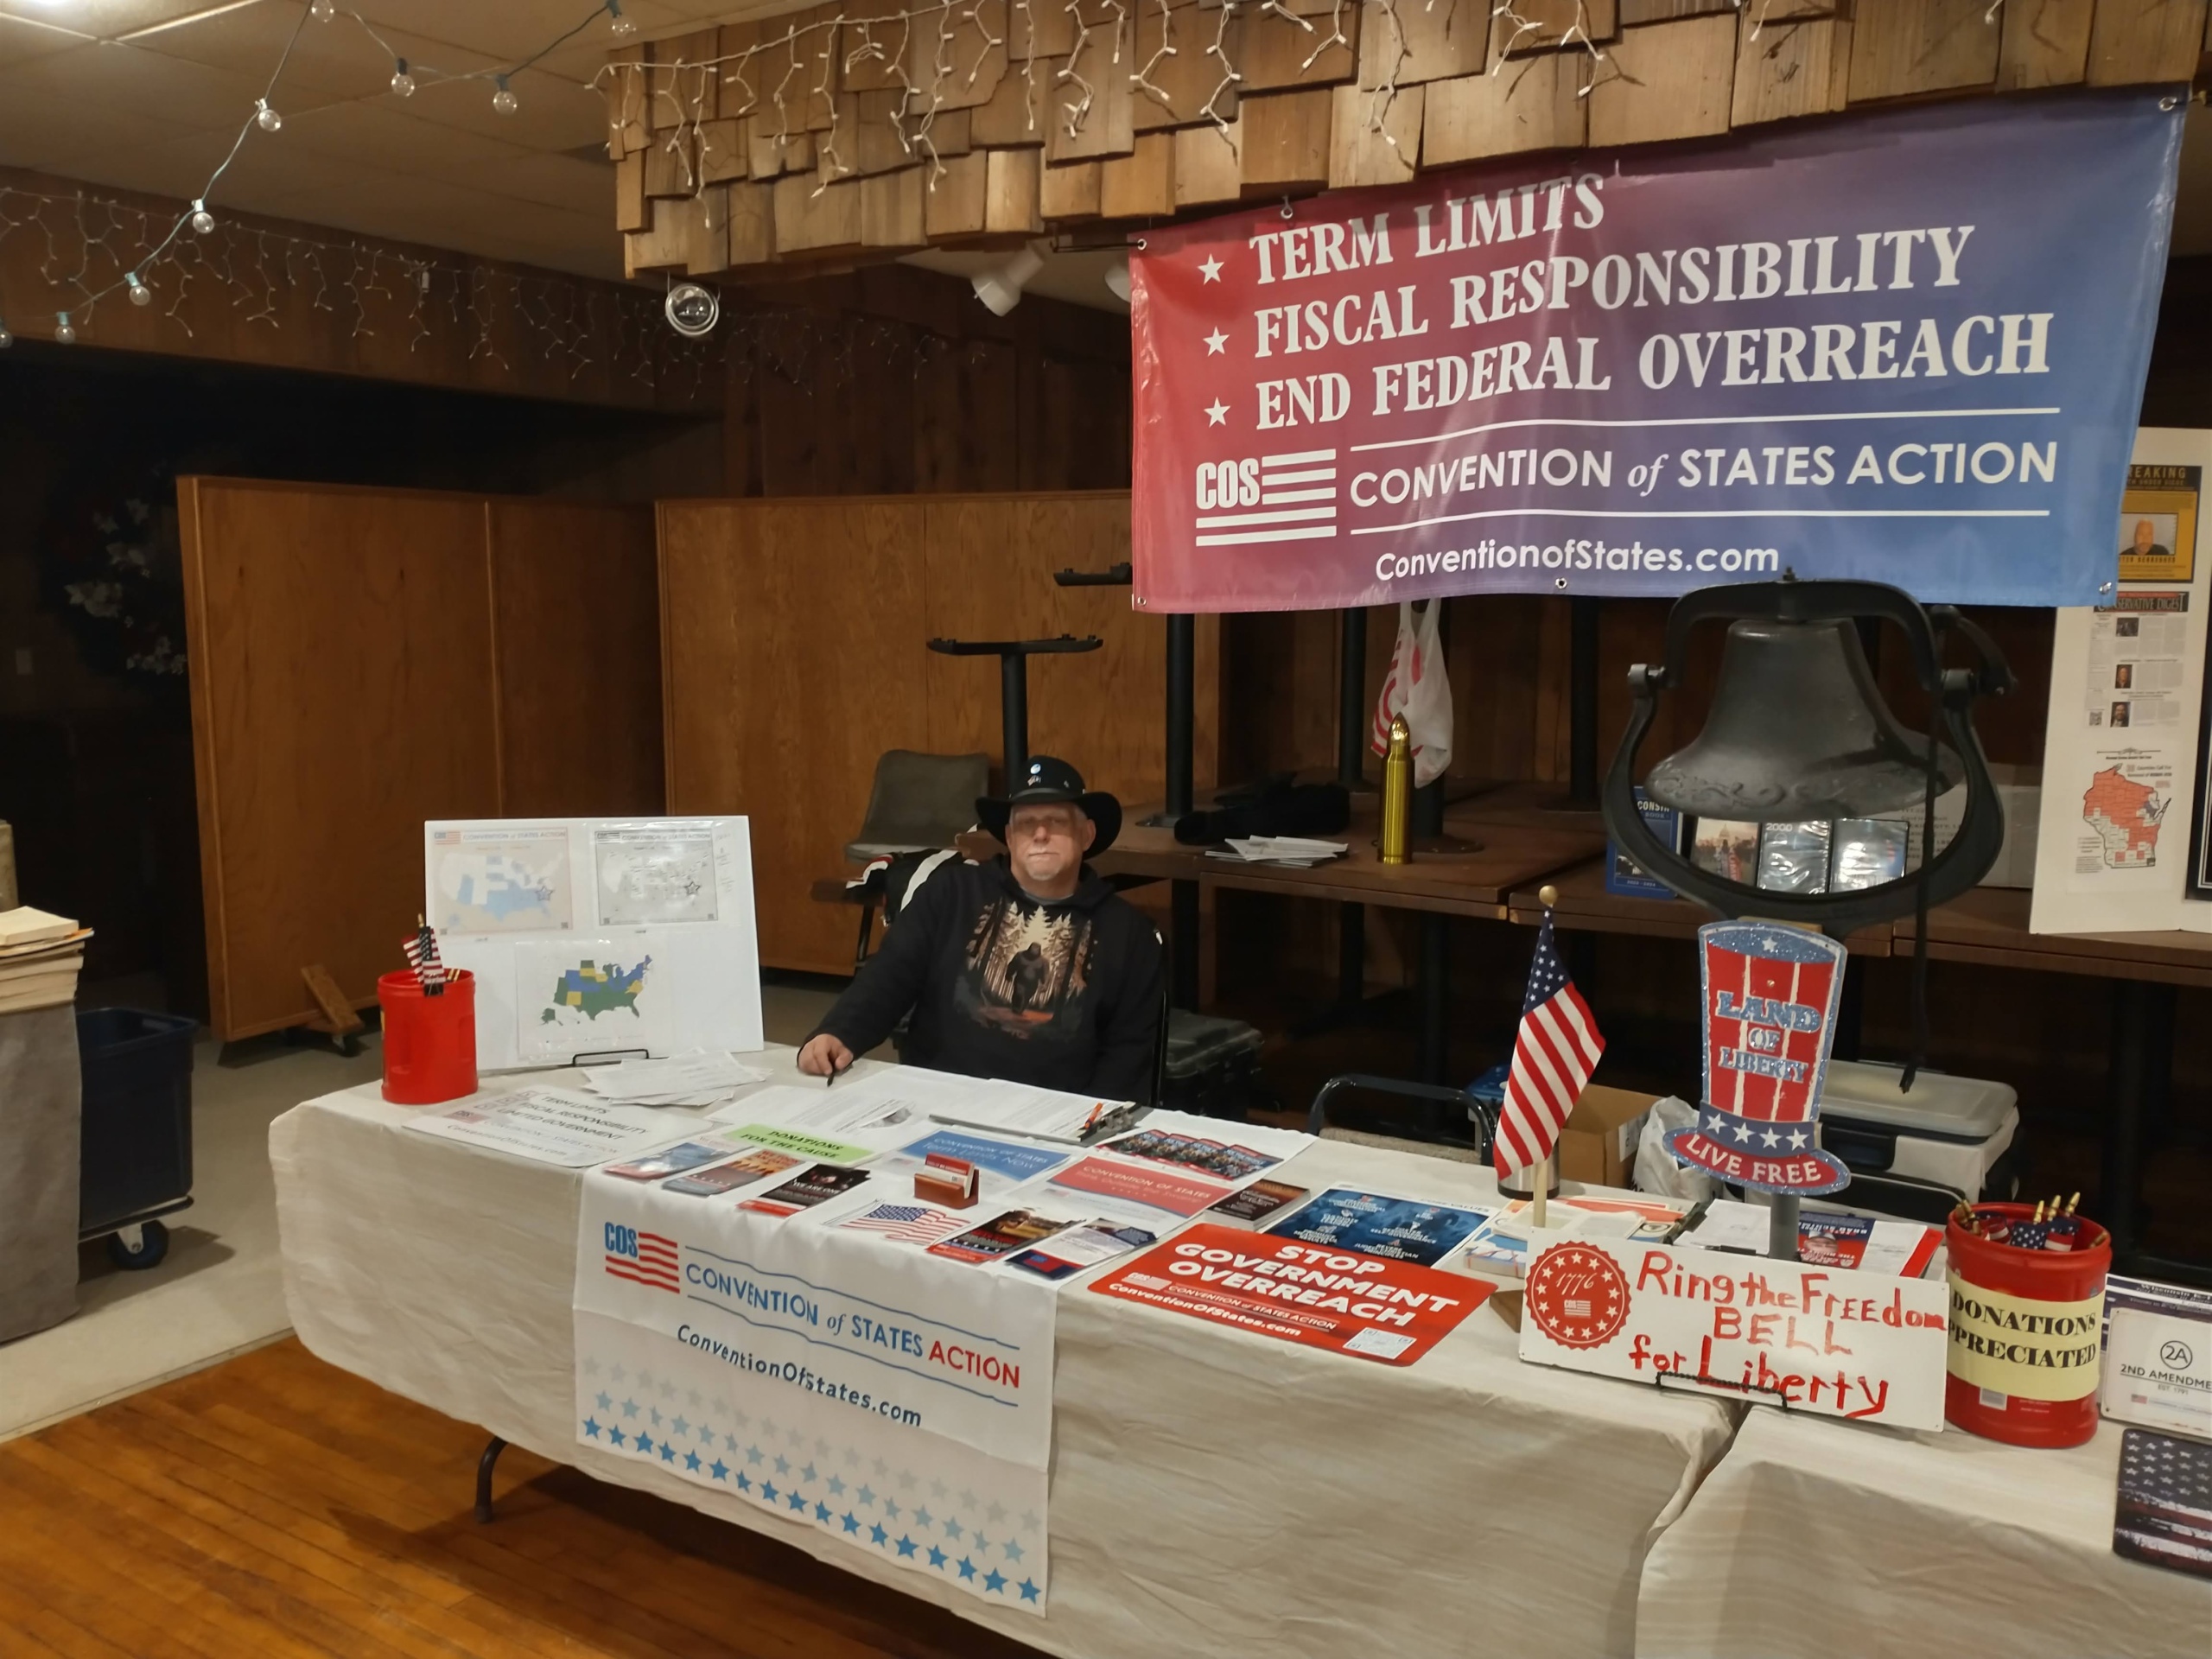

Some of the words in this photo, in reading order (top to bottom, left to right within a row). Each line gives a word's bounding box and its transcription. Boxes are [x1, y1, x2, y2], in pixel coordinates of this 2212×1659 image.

[1249, 213, 1394, 284] TERM
[1414, 173, 1605, 257] LIMITS
[1255, 285, 1428, 359] FISCAL
[1449, 226, 1975, 328] RESPONSIBILITY
[1255, 372, 1351, 430] END
[1372, 337, 1611, 416] FEDERAL
[1639, 313, 2054, 390] OVERREACH
[1196, 458, 1260, 510] COS
[1350, 448, 1612, 507] CONVENTION
[1627, 454, 1669, 497] of
[1678, 446, 1835, 486] STATES
[1847, 442, 2057, 485] ACTION
[2128, 465, 2187, 479] REAKING
[1376, 538, 1779, 582] ConventionofStates.com
[1637, 800, 1670, 812] CONSIN
[1765, 823, 1794, 833] 2000
[1715, 990, 1822, 1033] LAND
[1747, 1027, 1781, 1052] OF
[1718, 1046, 1808, 1084] LIBERTY
[740, 1134, 768, 1143] FOR
[770, 1140, 797, 1150] THE
[797, 1146, 841, 1159] CAUSE
[768, 1130, 844, 1151] DONATIONS
[933, 1137, 997, 1154] CONVENTION
[1686, 1134, 1741, 1176] LIVE
[1752, 1160, 1821, 1185] FREE
[1083, 1166, 1154, 1186] CONVENTION
[1174, 1185, 1211, 1199] STATES
[604, 1221, 639, 1259] COS
[1274, 1245, 1386, 1275] STOP
[1168, 1261, 1417, 1328] OVERREACH
[1174, 1243, 1460, 1312] GOVERNMENT
[1556, 1273, 1598, 1296] 1776
[1637, 1249, 1733, 1303] Ring
[1739, 1272, 1799, 1309] the
[685, 1263, 819, 1326] CONVENTION
[826, 1314, 847, 1337] of
[851, 1315, 924, 1358] STATES
[927, 1340, 1020, 1389] ACTION
[1108, 1282, 1302, 1337] ConventionOfStates.com
[1168, 1285, 1242, 1306] CONVENTION
[1253, 1305, 1290, 1320] STATES
[1289, 1314, 1338, 1330] ACTION
[1952, 1288, 2097, 1337] DONATIONS
[1713, 1306, 1853, 1357] BELL
[1948, 1318, 2097, 1369] PPRECIATED
[2164, 1344, 2189, 1364] 2A
[677, 1324, 923, 1427] ConventionOfStates.com
[1629, 1333, 1687, 1375] for
[1696, 1335, 1889, 1420] Liberty
[2120, 1363, 2145, 1376] 2ND
